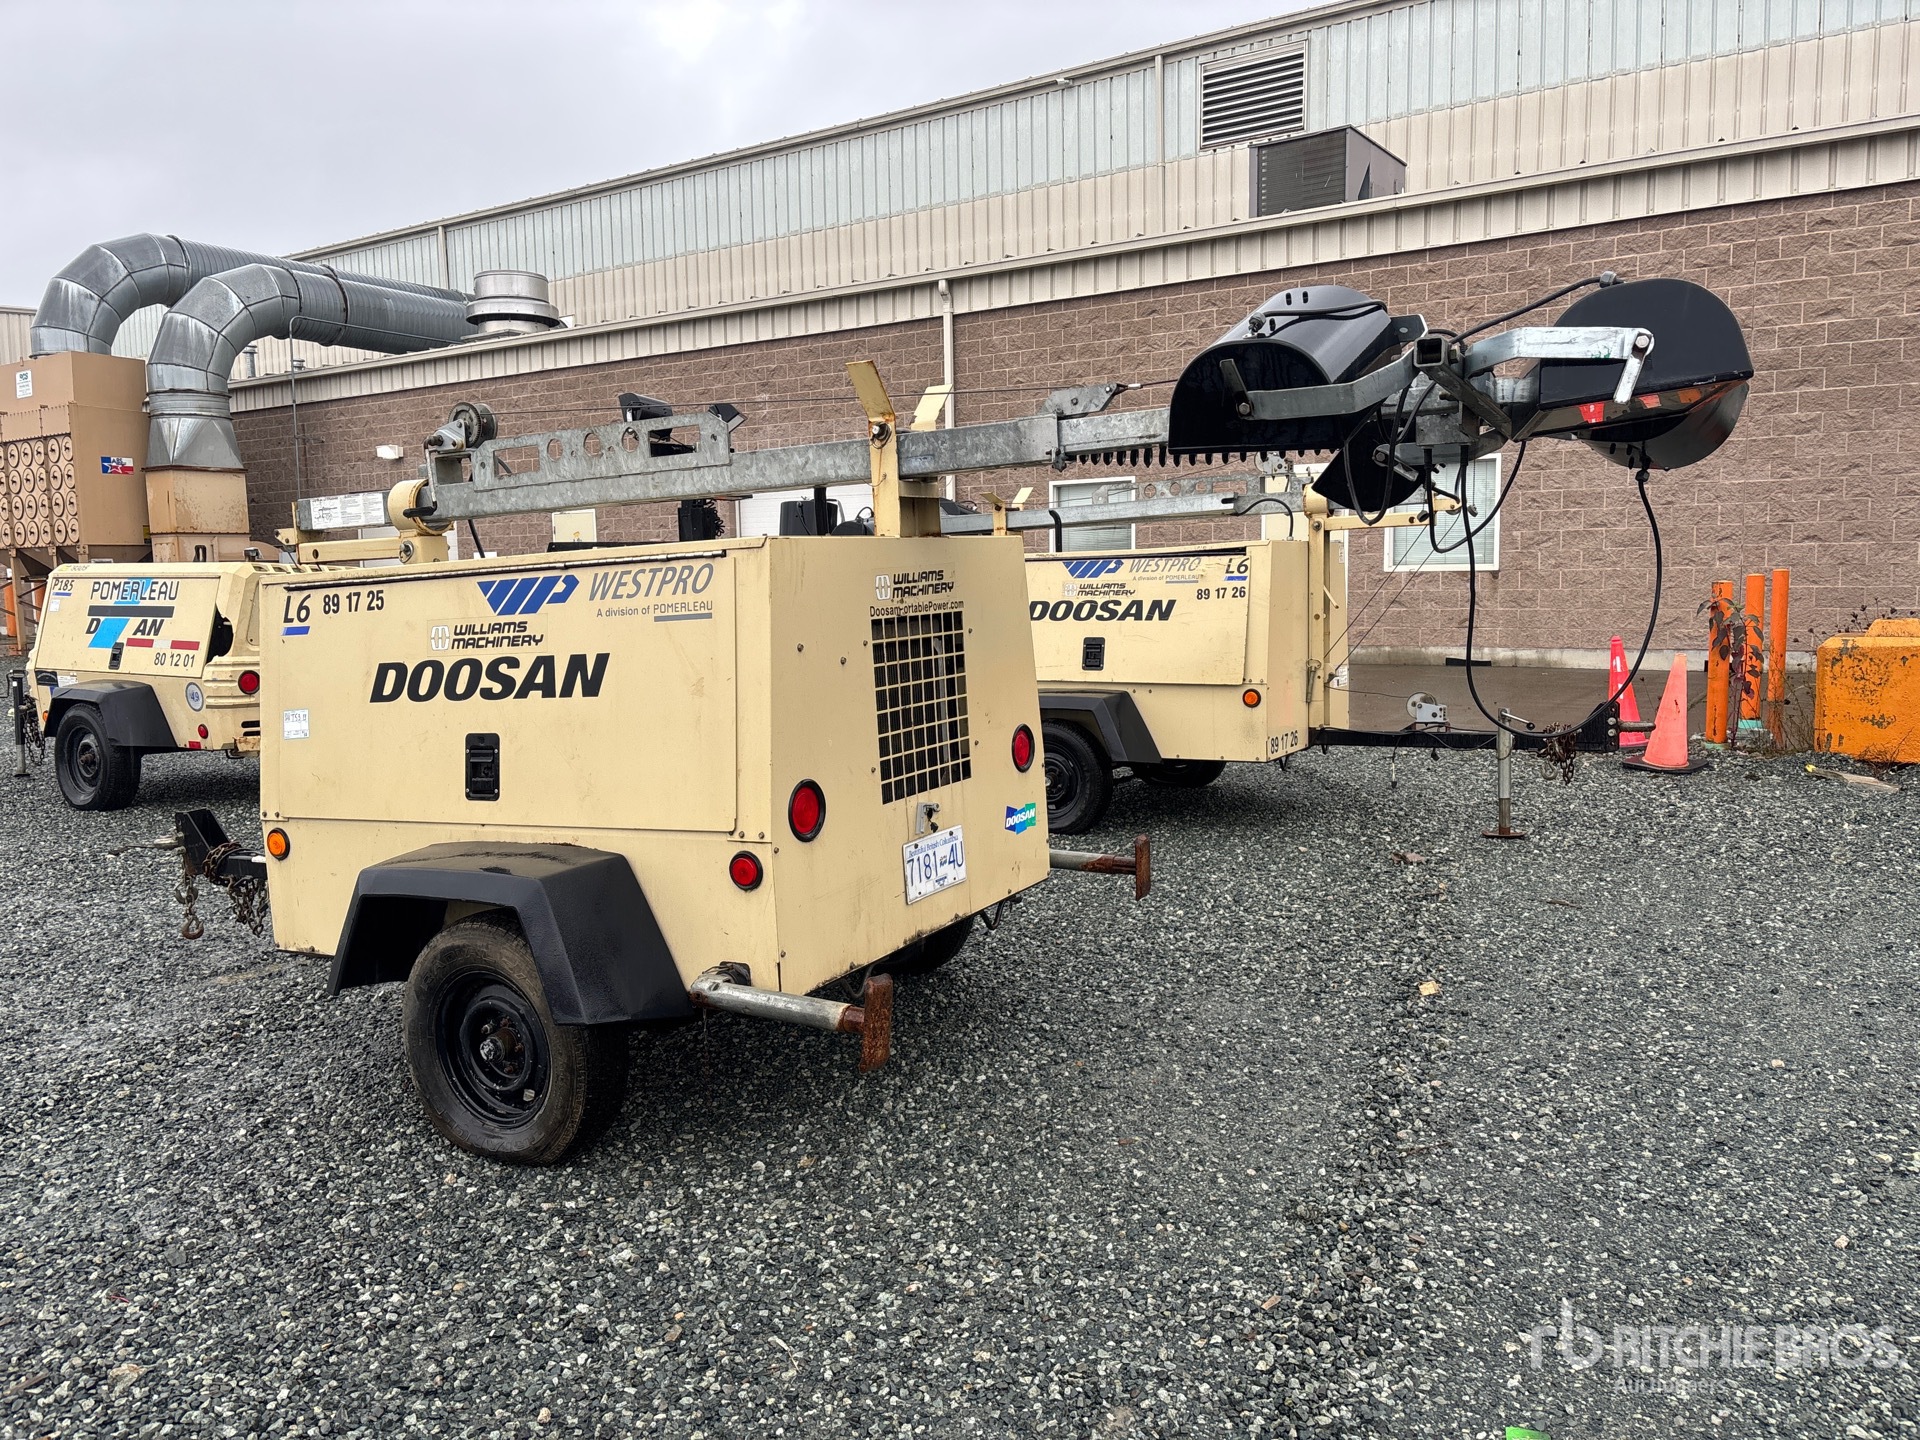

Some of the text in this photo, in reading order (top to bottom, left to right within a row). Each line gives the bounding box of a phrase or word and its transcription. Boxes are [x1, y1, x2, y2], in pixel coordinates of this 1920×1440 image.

[1129, 557, 1202, 574] WESTPRO
[1225, 557, 1250, 575] L6
[52, 579, 75, 592] P185
[588, 562, 714, 601] WESTPRO
[893, 570, 944, 585] WILLIAMS
[90, 581, 180, 600] POMERLEAU
[892, 582, 955, 599] MACHINERY
[1077, 589, 1136, 597] MACHINERY
[1196, 586, 1246, 600] 89 17 26
[283, 593, 312, 624] L6
[323, 590, 385, 615] 89 17 25
[596, 601, 713, 618] A division of POMERLEAU
[1029, 599, 1177, 621] DOOSAN
[453, 620, 528, 636] WILLIAMS
[451, 634, 544, 650] MACHINERY
[154, 652, 196, 668] 80 12 01
[369, 652, 611, 703] DOOSAN
[190, 691, 200, 702] 49
[1270, 730, 1298, 755] 89 17 26
[1005, 807, 1036, 828] DOOSAN
